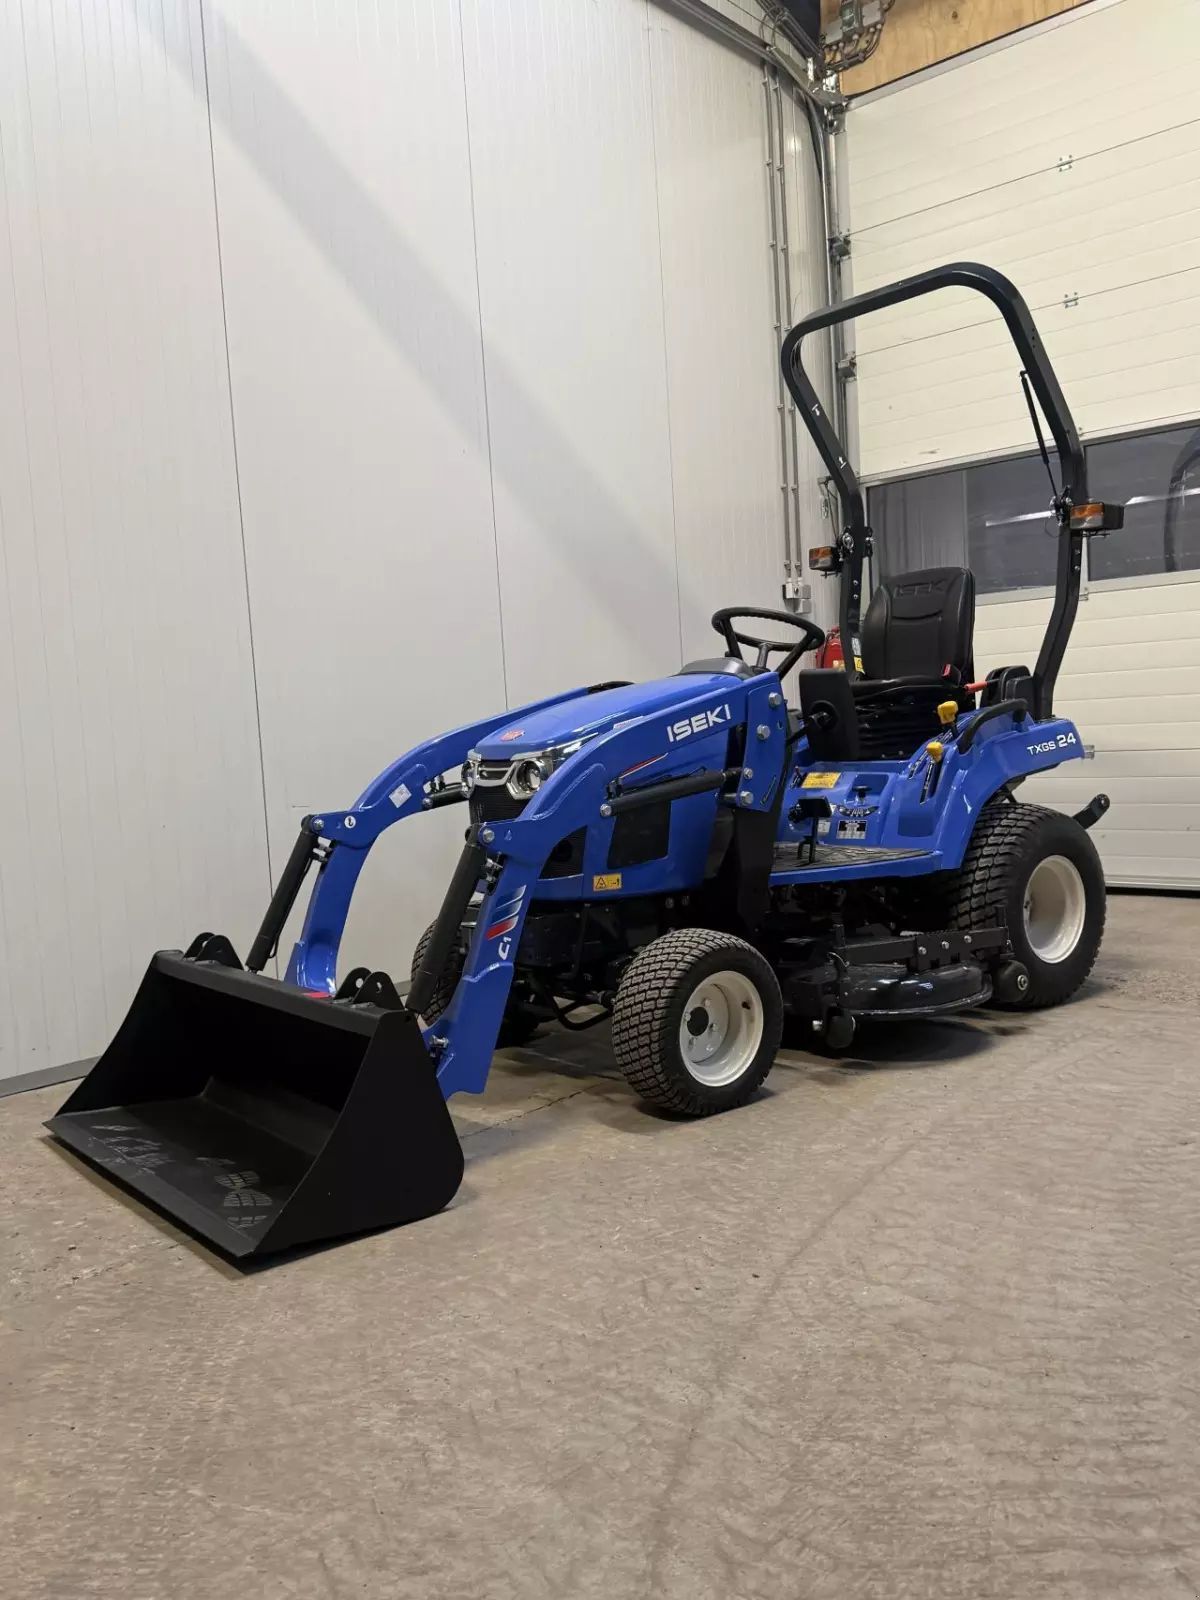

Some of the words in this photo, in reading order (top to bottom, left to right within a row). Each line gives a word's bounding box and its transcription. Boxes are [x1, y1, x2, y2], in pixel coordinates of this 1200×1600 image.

[667, 704, 731, 742] ISEKI
[1027, 741, 1056, 755] TXGS
[1057, 733, 1076, 747] 24
